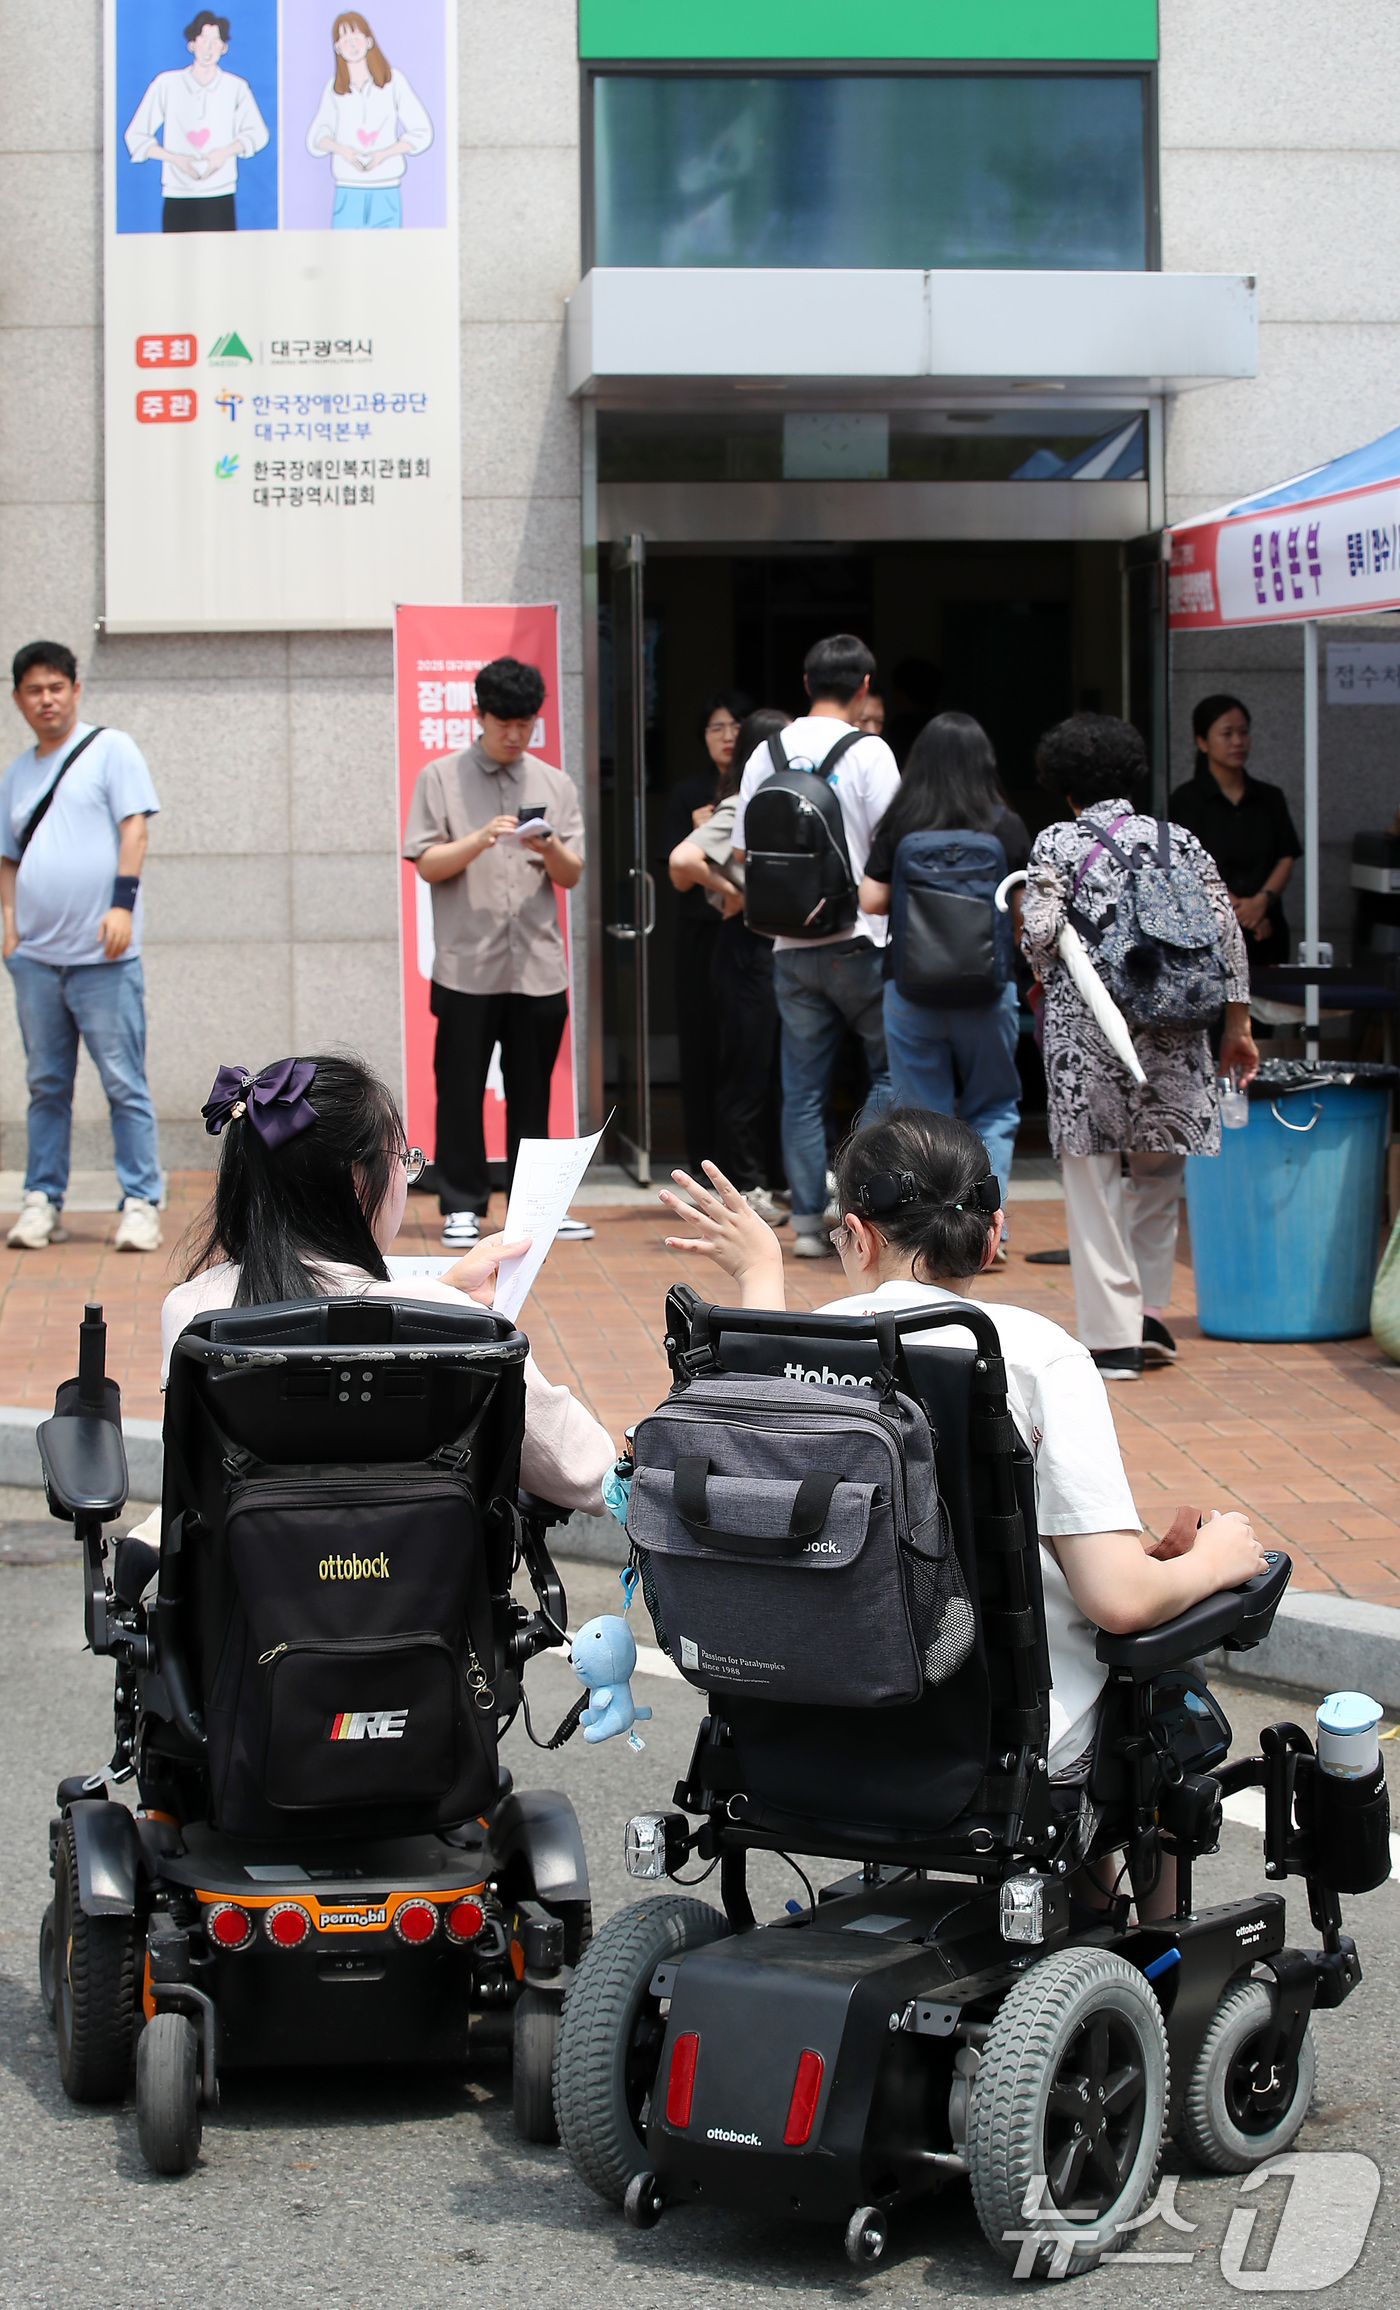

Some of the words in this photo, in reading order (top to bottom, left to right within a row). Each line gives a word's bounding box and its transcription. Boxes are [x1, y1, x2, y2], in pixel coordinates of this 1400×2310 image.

[271, 339, 373, 357] 대구광역시
[252, 392, 427, 416] 한국장애인고용공단
[254, 421, 372, 442] 대구지역본부
[254, 458, 431, 481] 한국장애인복지관협회
[253, 485, 375, 507] 대구광역시협회
[1253, 522, 1322, 604] 운영본부
[417, 681, 479, 713] 장애
[318, 1551, 390, 1581] ottobock
[701, 1649, 727, 1663] Passion
[727, 1655, 739, 1665] for
[739, 1657, 786, 1671] Paralympics
[702, 1662, 720, 1672] since
[721, 1665, 741, 1676] 1988
[320, 1907, 387, 1928] permobil
[706, 2127, 762, 2146] ottobock.
